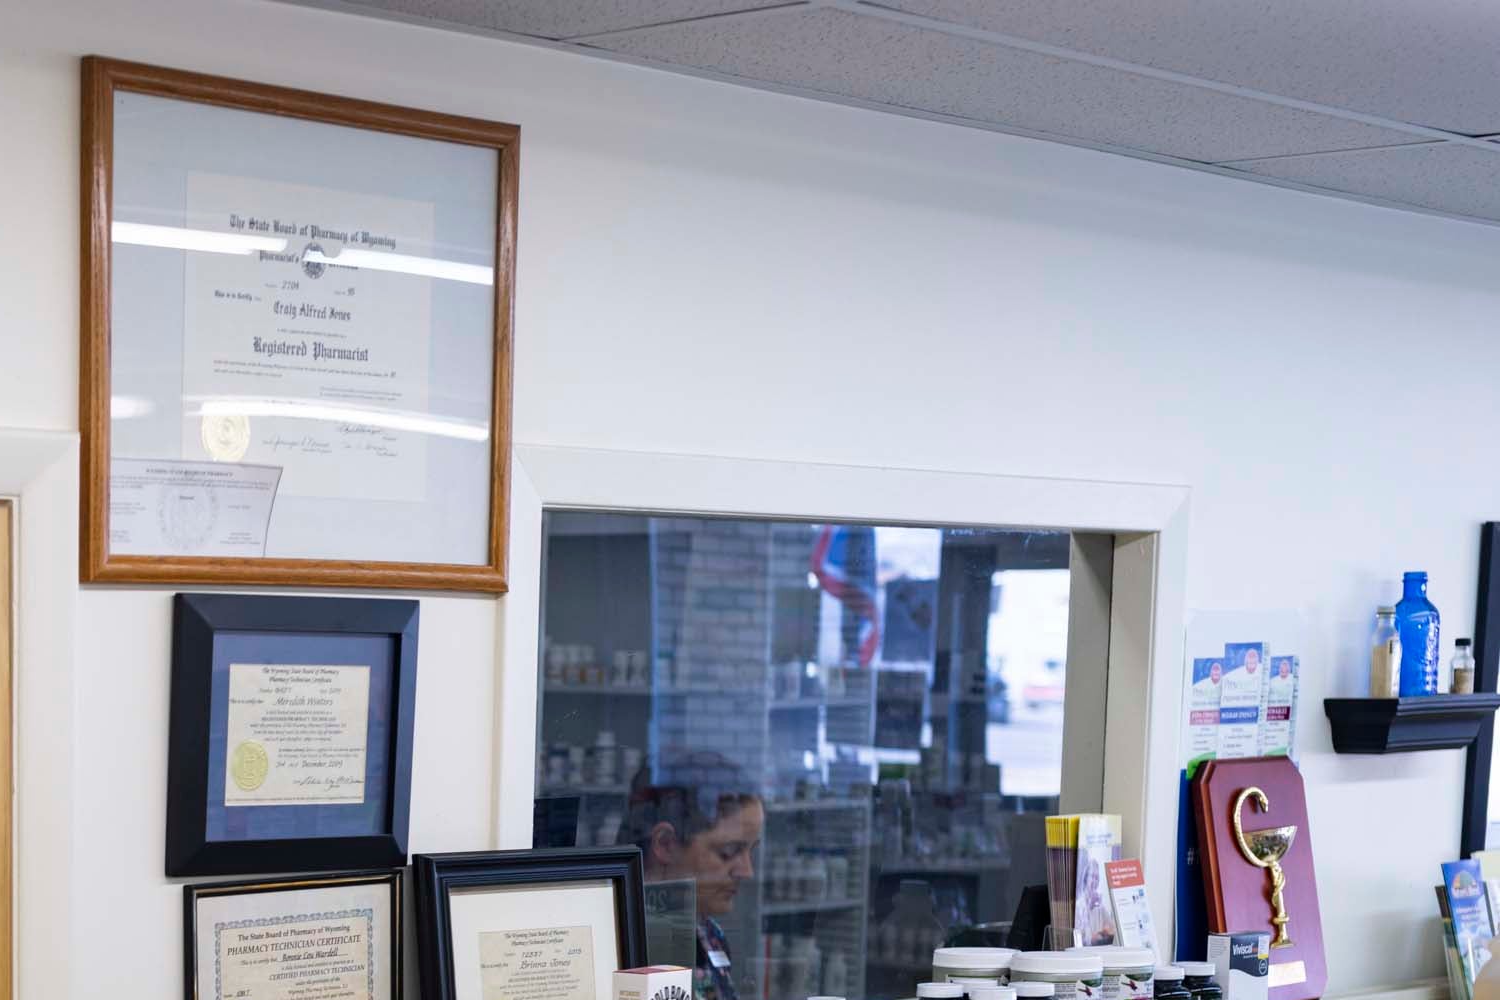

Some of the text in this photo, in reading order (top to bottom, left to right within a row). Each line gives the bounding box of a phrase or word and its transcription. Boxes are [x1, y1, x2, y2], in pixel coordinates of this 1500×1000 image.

[229, 214, 245, 229] The
[249, 217, 270, 232] State
[299, 224, 309, 236] of
[311, 225, 348, 244] Pharmacy
[350, 231, 359, 242] of
[361, 232, 396, 250] Wyoming
[273, 301, 351, 321] Craig Alfred Jones
[253, 336, 369, 362] Registered Pharmacist
[238, 933, 249, 942] The
[250, 931, 265, 941] State
[265, 930, 282, 940] Board
[290, 927, 316, 938] Pharmacy
[324, 924, 350, 934] Wyoming
[227, 934, 362, 956] PHARMACY TECHNICIAN CERTIFICATE
